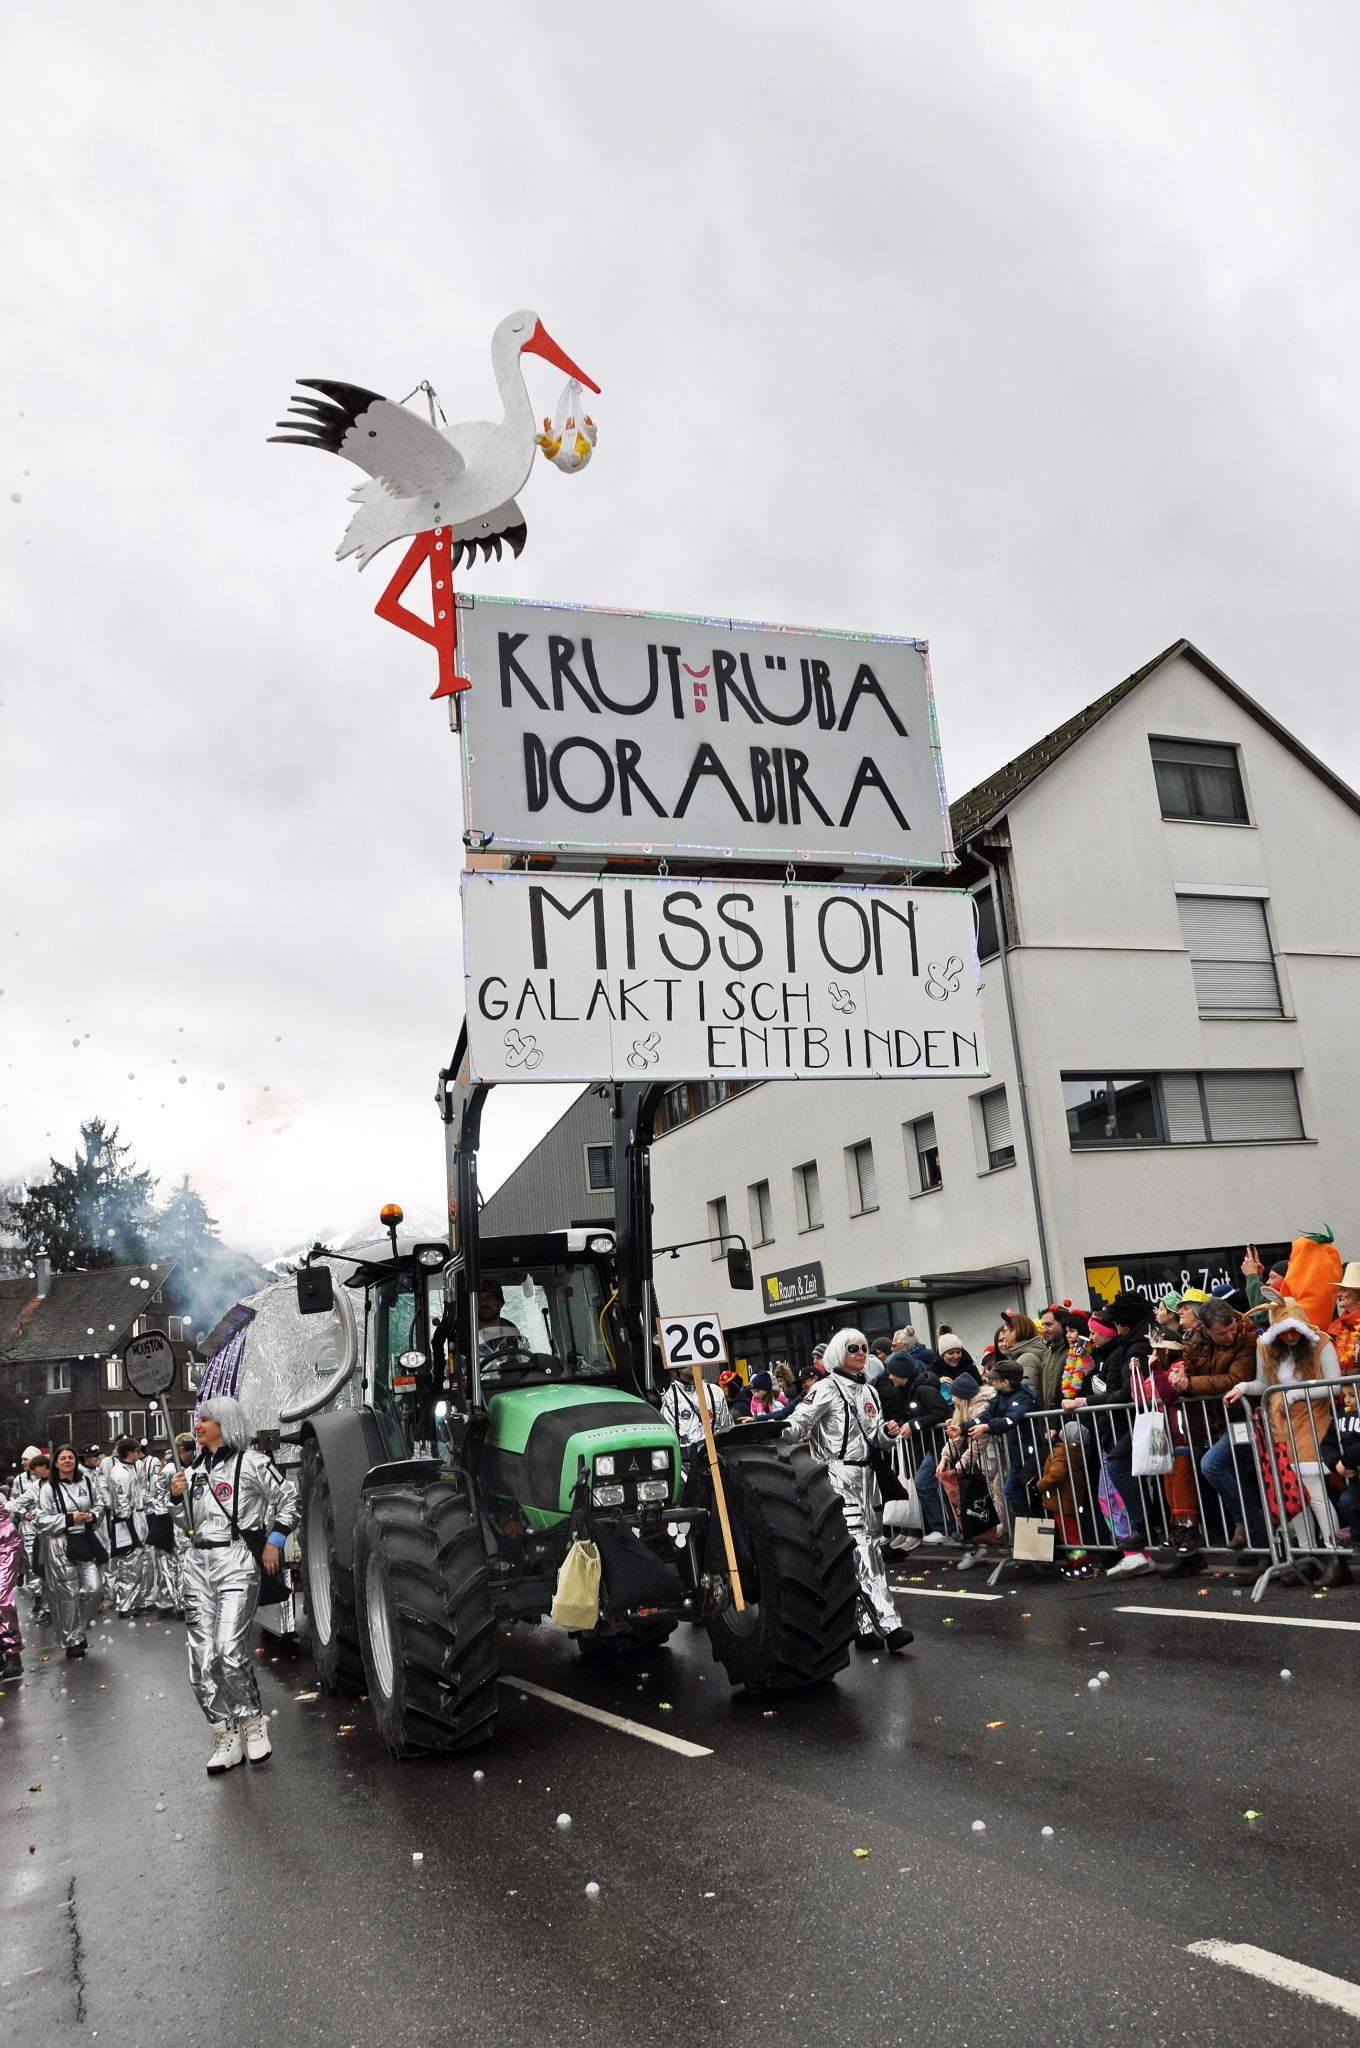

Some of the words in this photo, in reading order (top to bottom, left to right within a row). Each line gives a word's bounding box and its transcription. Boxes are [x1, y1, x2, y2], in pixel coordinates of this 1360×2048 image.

[498, 632, 684, 719] KRUT
[712, 650, 908, 736] RÜBA
[529, 886, 919, 976] MISSION
[478, 976, 811, 1022] GALAKTISCH
[708, 1026, 979, 1068] ENTBINDEN
[779, 1281, 797, 1300] Raum
[797, 1276, 804, 1296] &
[803, 1274, 818, 1294] Zeit
[132, 1339, 163, 1355] HOUSTON
[665, 1321, 720, 1362] 26
